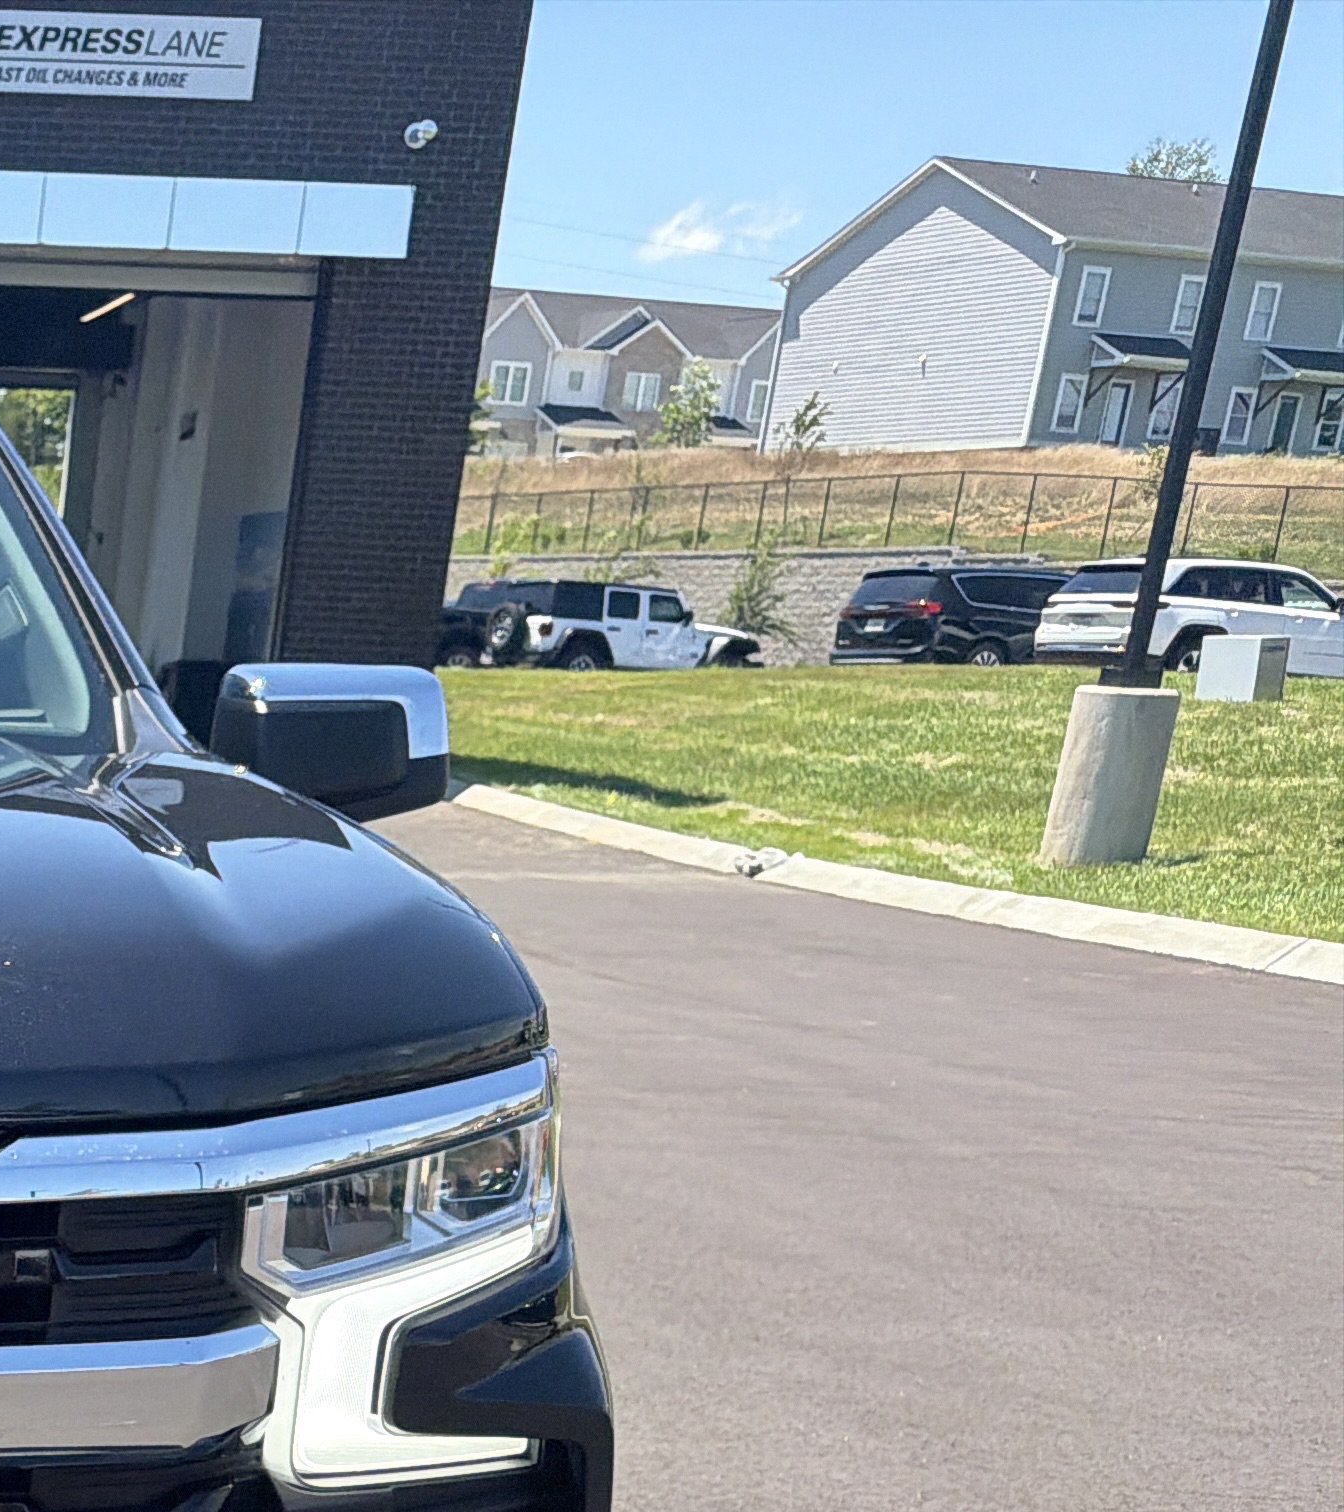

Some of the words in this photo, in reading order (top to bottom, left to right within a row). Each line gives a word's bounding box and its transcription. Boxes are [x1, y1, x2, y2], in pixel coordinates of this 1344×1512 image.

[25, 67, 49, 84] OIL
[52, 69, 126, 87] CHANGES
[126, 70, 139, 87] &
[142, 71, 189, 89] MORE
